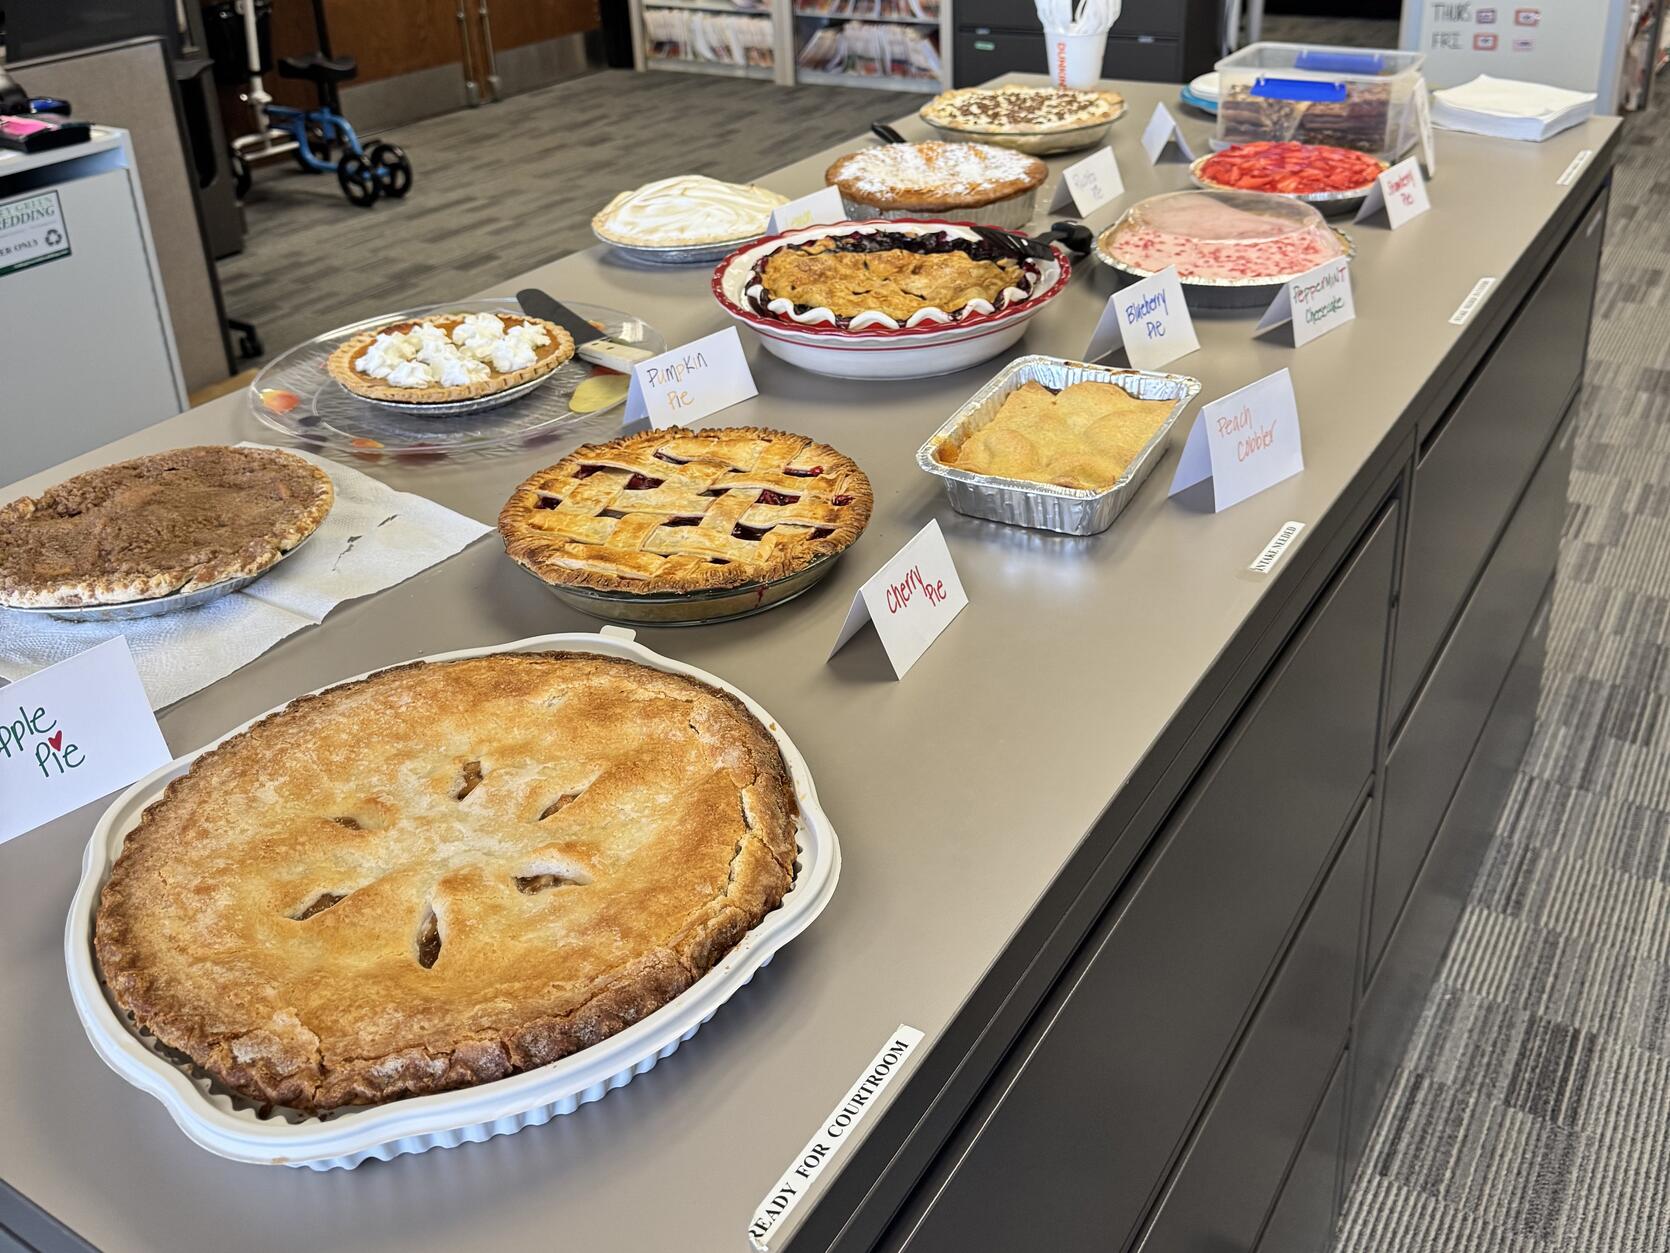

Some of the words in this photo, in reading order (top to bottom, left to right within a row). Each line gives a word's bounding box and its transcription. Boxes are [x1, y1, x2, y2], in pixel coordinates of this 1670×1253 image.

[1146, 320, 1166, 339] Pie
[667, 390, 695, 410] Pie
[1216, 405, 1253, 438] Peach
[1271, 526, 1297, 550] NEEDED
[886, 565, 928, 614] Cherry
[925, 579, 947, 607] Pie
[0, 706, 57, 758] pple
[35, 741, 86, 778] Pie
[795, 1143, 831, 1179] FOR
[827, 1039, 909, 1138] COURTROOM
